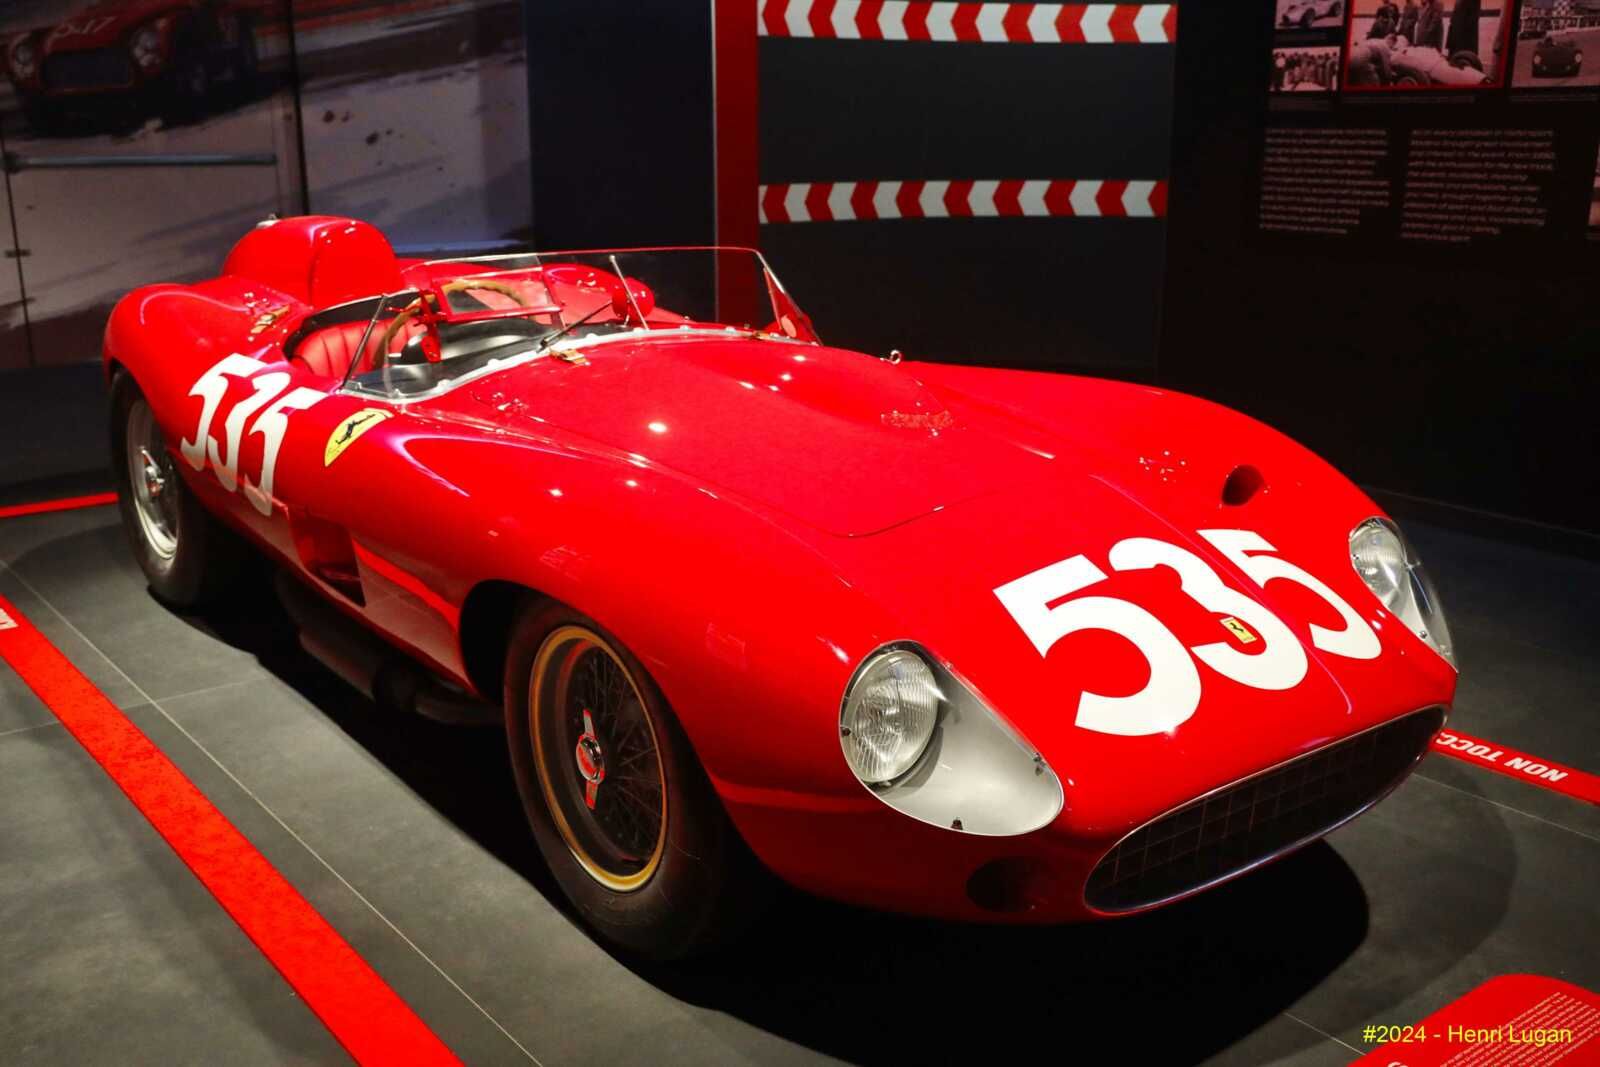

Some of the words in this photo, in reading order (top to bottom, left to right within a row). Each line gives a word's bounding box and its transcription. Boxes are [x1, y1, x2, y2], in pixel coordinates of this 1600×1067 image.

[180, 352, 328, 516] 535
[992, 529, 1382, 736] 535
[1504, 756, 1569, 782] NON
